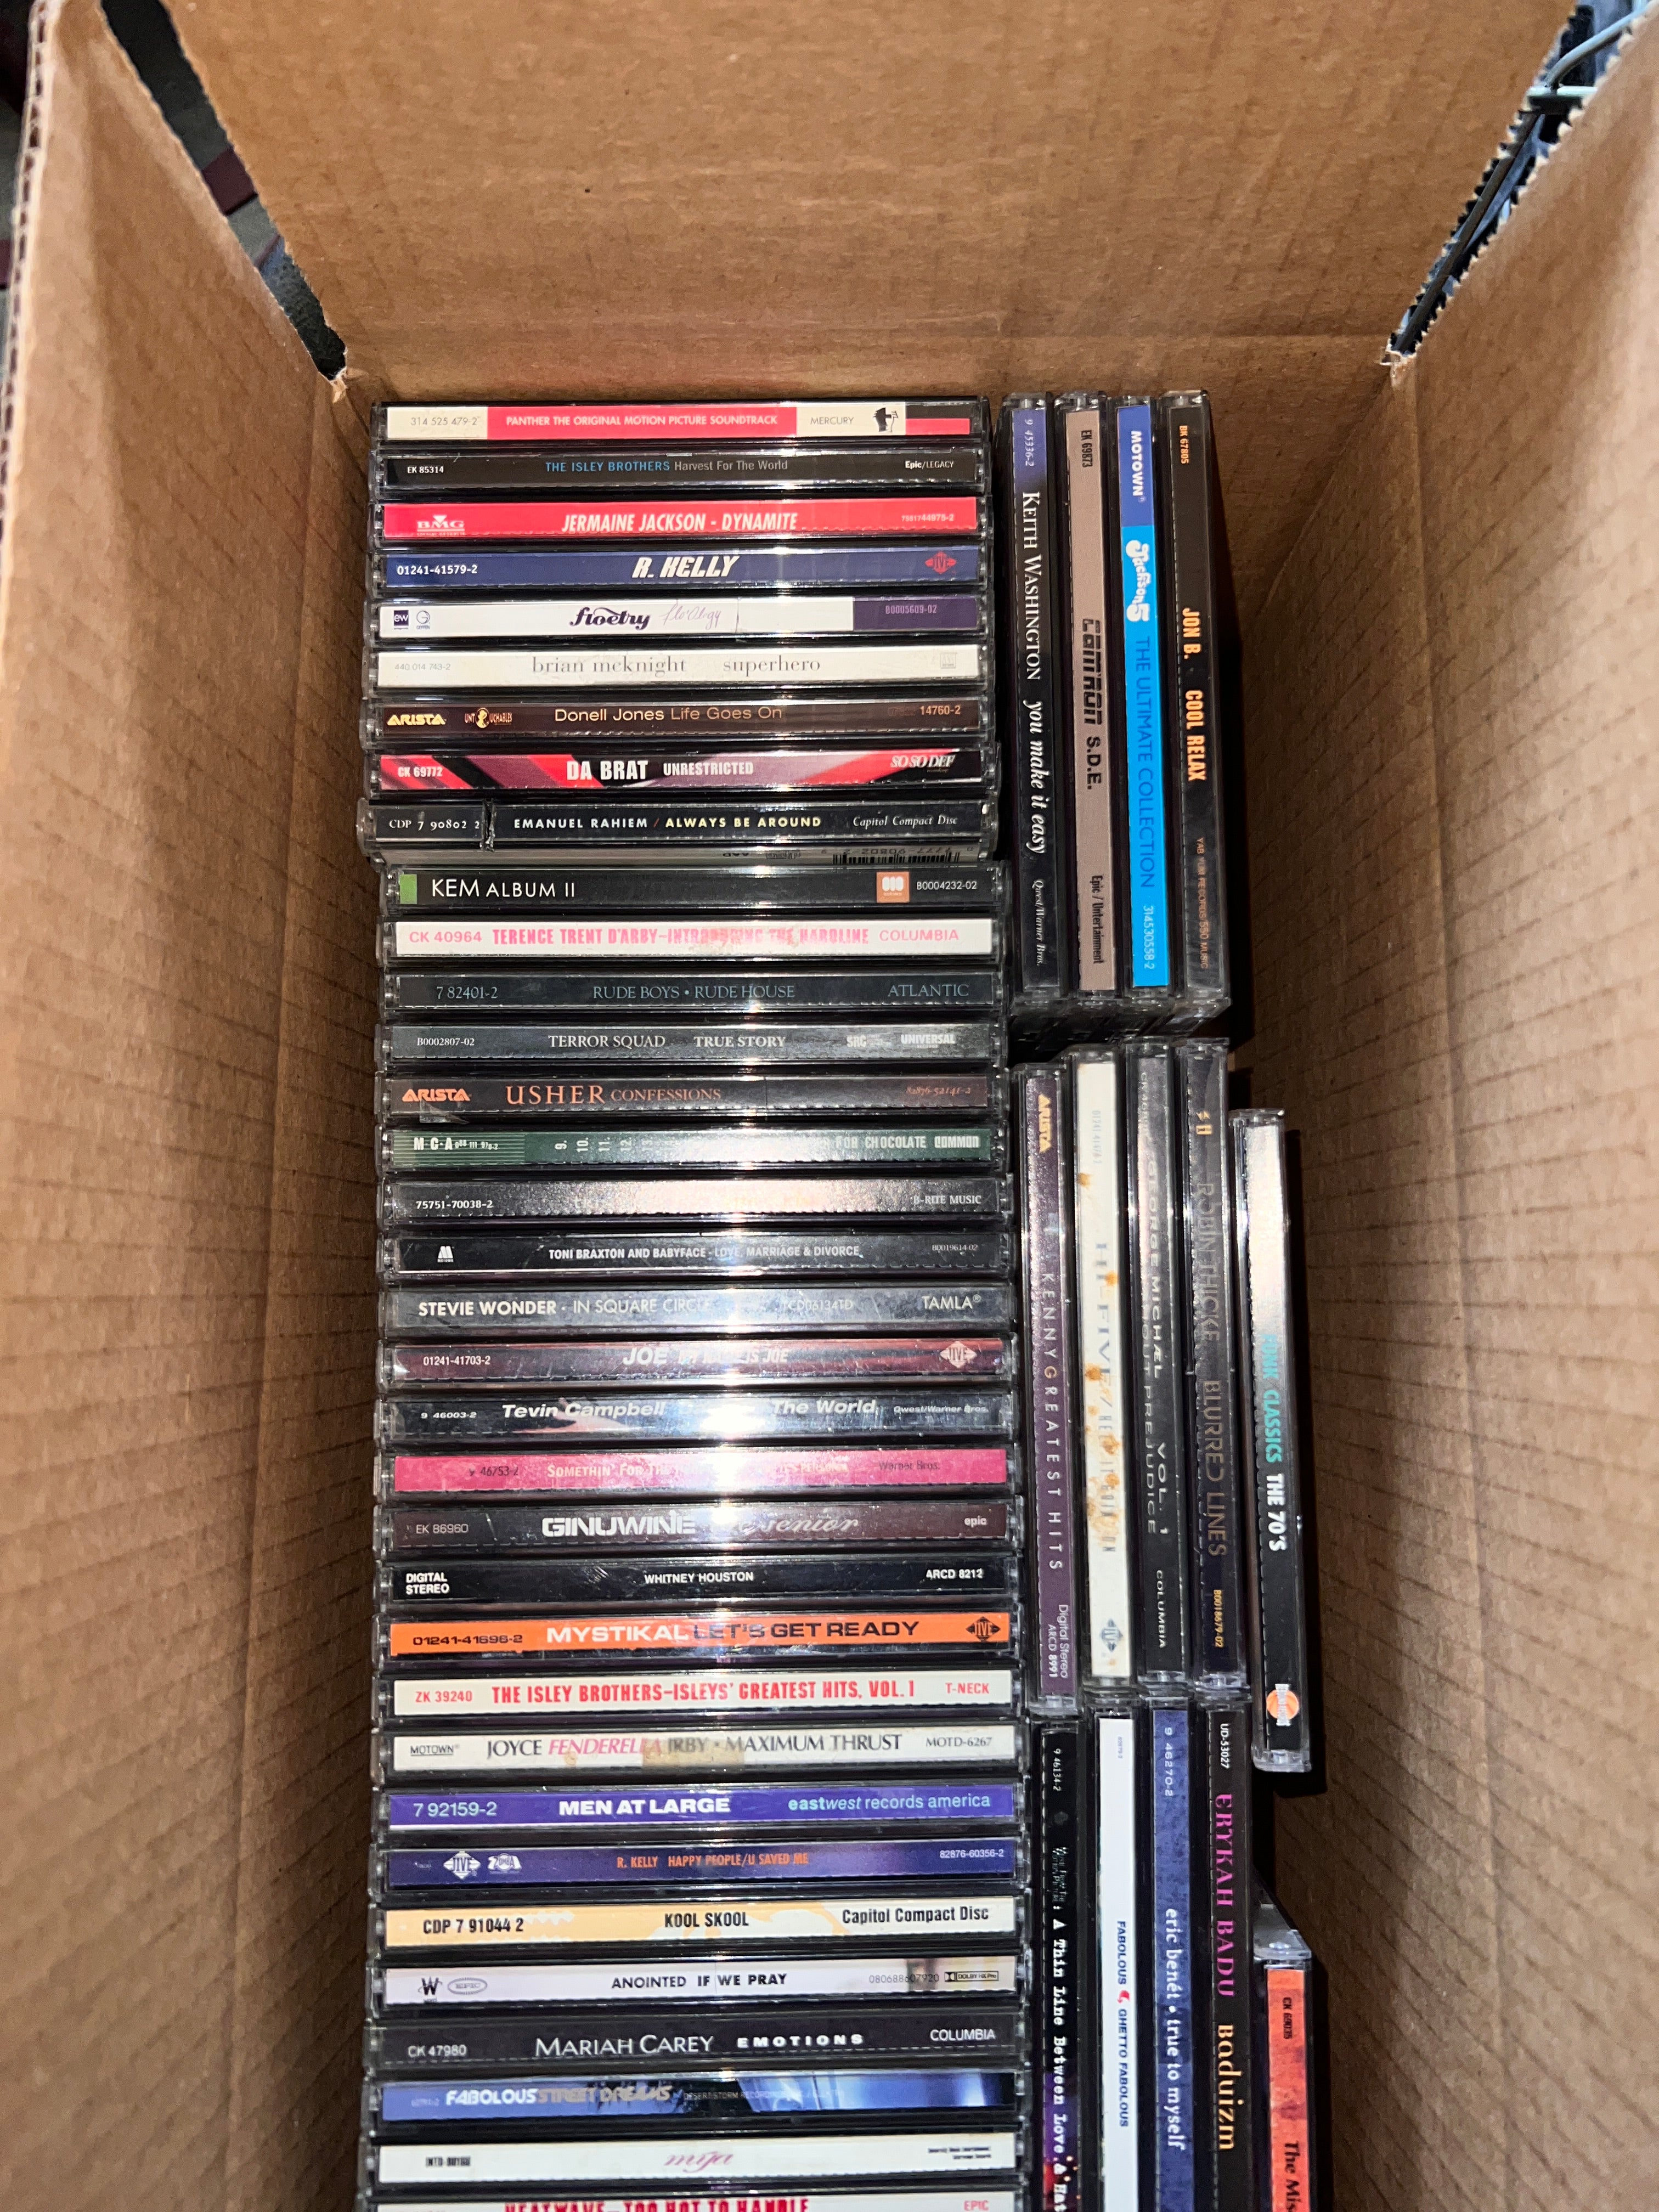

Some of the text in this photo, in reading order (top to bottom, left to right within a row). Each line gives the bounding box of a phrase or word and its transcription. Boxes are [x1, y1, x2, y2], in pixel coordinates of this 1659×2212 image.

[506, 415, 777, 426] PANTHER THE ORIGINAL MOTION PICTURE SOUNDTRACK
[810, 416, 854, 426] MERCURY
[408, 465, 444, 474] EK 85314
[546, 460, 787, 472] THE ISLEY BROTHERS Harvest For The World
[1131, 431, 1143, 496] MOTOWN
[562, 512, 798, 532] JERMAINE JACKSON DYNAMITE
[397, 565, 477, 575] 01241-41579-2
[659, 555, 740, 578] KELLY
[533, 655, 820, 677] brian mcknight superhero
[1023, 492, 1049, 854] KEITH WASHINGTON you make easy
[1182, 608, 1205, 782] JON COOL RELAX
[555, 707, 782, 723] Donell Jones Life Goes On
[920, 706, 960, 715] 14760-2
[567, 760, 753, 780] DA BRAT UNRESTRICTED
[1086, 736, 1101, 790] S.D.E.
[1136, 636, 1154, 888] THE ULTIMATE COLLECTION
[414, 766, 443, 777] 69772
[515, 817, 821, 828] EMANUEL RAHIEM ALWAYS BE AROUND
[432, 879, 555, 897] KEM ALBUM
[1092, 876, 1102, 893] Epic
[434, 932, 482, 943] 40964
[493, 929, 602, 944] TERENCE TRENT
[879, 930, 959, 942] COLUMBIA
[594, 986, 794, 998] RUDE BOYS RUDE HOUSE
[888, 984, 969, 997] ATLANTIC
[549, 1035, 786, 1049] TERROR SQUAD TRUE STORY
[506, 1085, 721, 1105] USHER CONFESSIONS
[416, 1200, 493, 1209] 75751-70038-2
[950, 1195, 981, 1204] MUSIC
[549, 1245, 859, 1259] TONI BRAXTON AND BABYFACE MARRIAGE DIVORCE
[419, 1301, 556, 1317] STEVIE WONDER
[1151, 1277, 1163, 1378] MICHAEL
[423, 1356, 490, 1366] 01241-41703-2
[623, 1347, 667, 1365] JOE
[502, 1403, 665, 1418] Tevin Campbell
[1041, 1273, 1063, 1570] KENNY HITS
[1263, 1390, 1286, 1552] CLASSICS THE 70'S
[542, 1516, 695, 1536] GINUWINE
[964, 1516, 986, 1526] epic
[1207, 1493, 1226, 1557] LINES
[407, 1573, 447, 1583] DIGITAL
[645, 1572, 754, 1583] WHITNEY HOUSTON
[926, 1569, 955, 1579] ARCD
[406, 1584, 450, 1594] STEREO
[1156, 1570, 1166, 1647] COLUMBIA
[547, 1622, 918, 1644] MYSTIKAL GET READY
[1048, 1624, 1057, 1654] ARCD
[1058, 1604, 1069, 1679] Digital Stereo
[493, 1681, 816, 1703] THE ISLEY GREATEST
[946, 1682, 989, 1694] T-NECK
[435, 1691, 472, 1702] 39240
[487, 1734, 902, 1759] JOYCE MAXIMUM THRUST
[559, 1798, 731, 1815] MEN AT LARGE
[865, 1793, 990, 1808] records america
[631, 1853, 808, 1867] KELLY HAPPY SAVED ME
[1215, 1793, 1234, 1997] ERYKAH BADU
[664, 1912, 748, 1928] KOOL SKOOL
[843, 1906, 989, 1925] Capitol Compact Disc
[424, 1919, 510, 1934] CDP 91044
[612, 1974, 787, 1989] ANOINTED IF WE PRAY
[1053, 1939, 1068, 2106] Thin Line Between
[1117, 1921, 1129, 2128] FABOLOUS GHETTO FABOLOUS
[930, 2029, 995, 2041] COLUMBIA
[408, 2046, 425, 2057] CK
[536, 2034, 864, 2057] MARIAH CAREY EMOTIONS
[1164, 2019, 1186, 2151] true to myself
[1284, 2141, 1299, 2173] The
